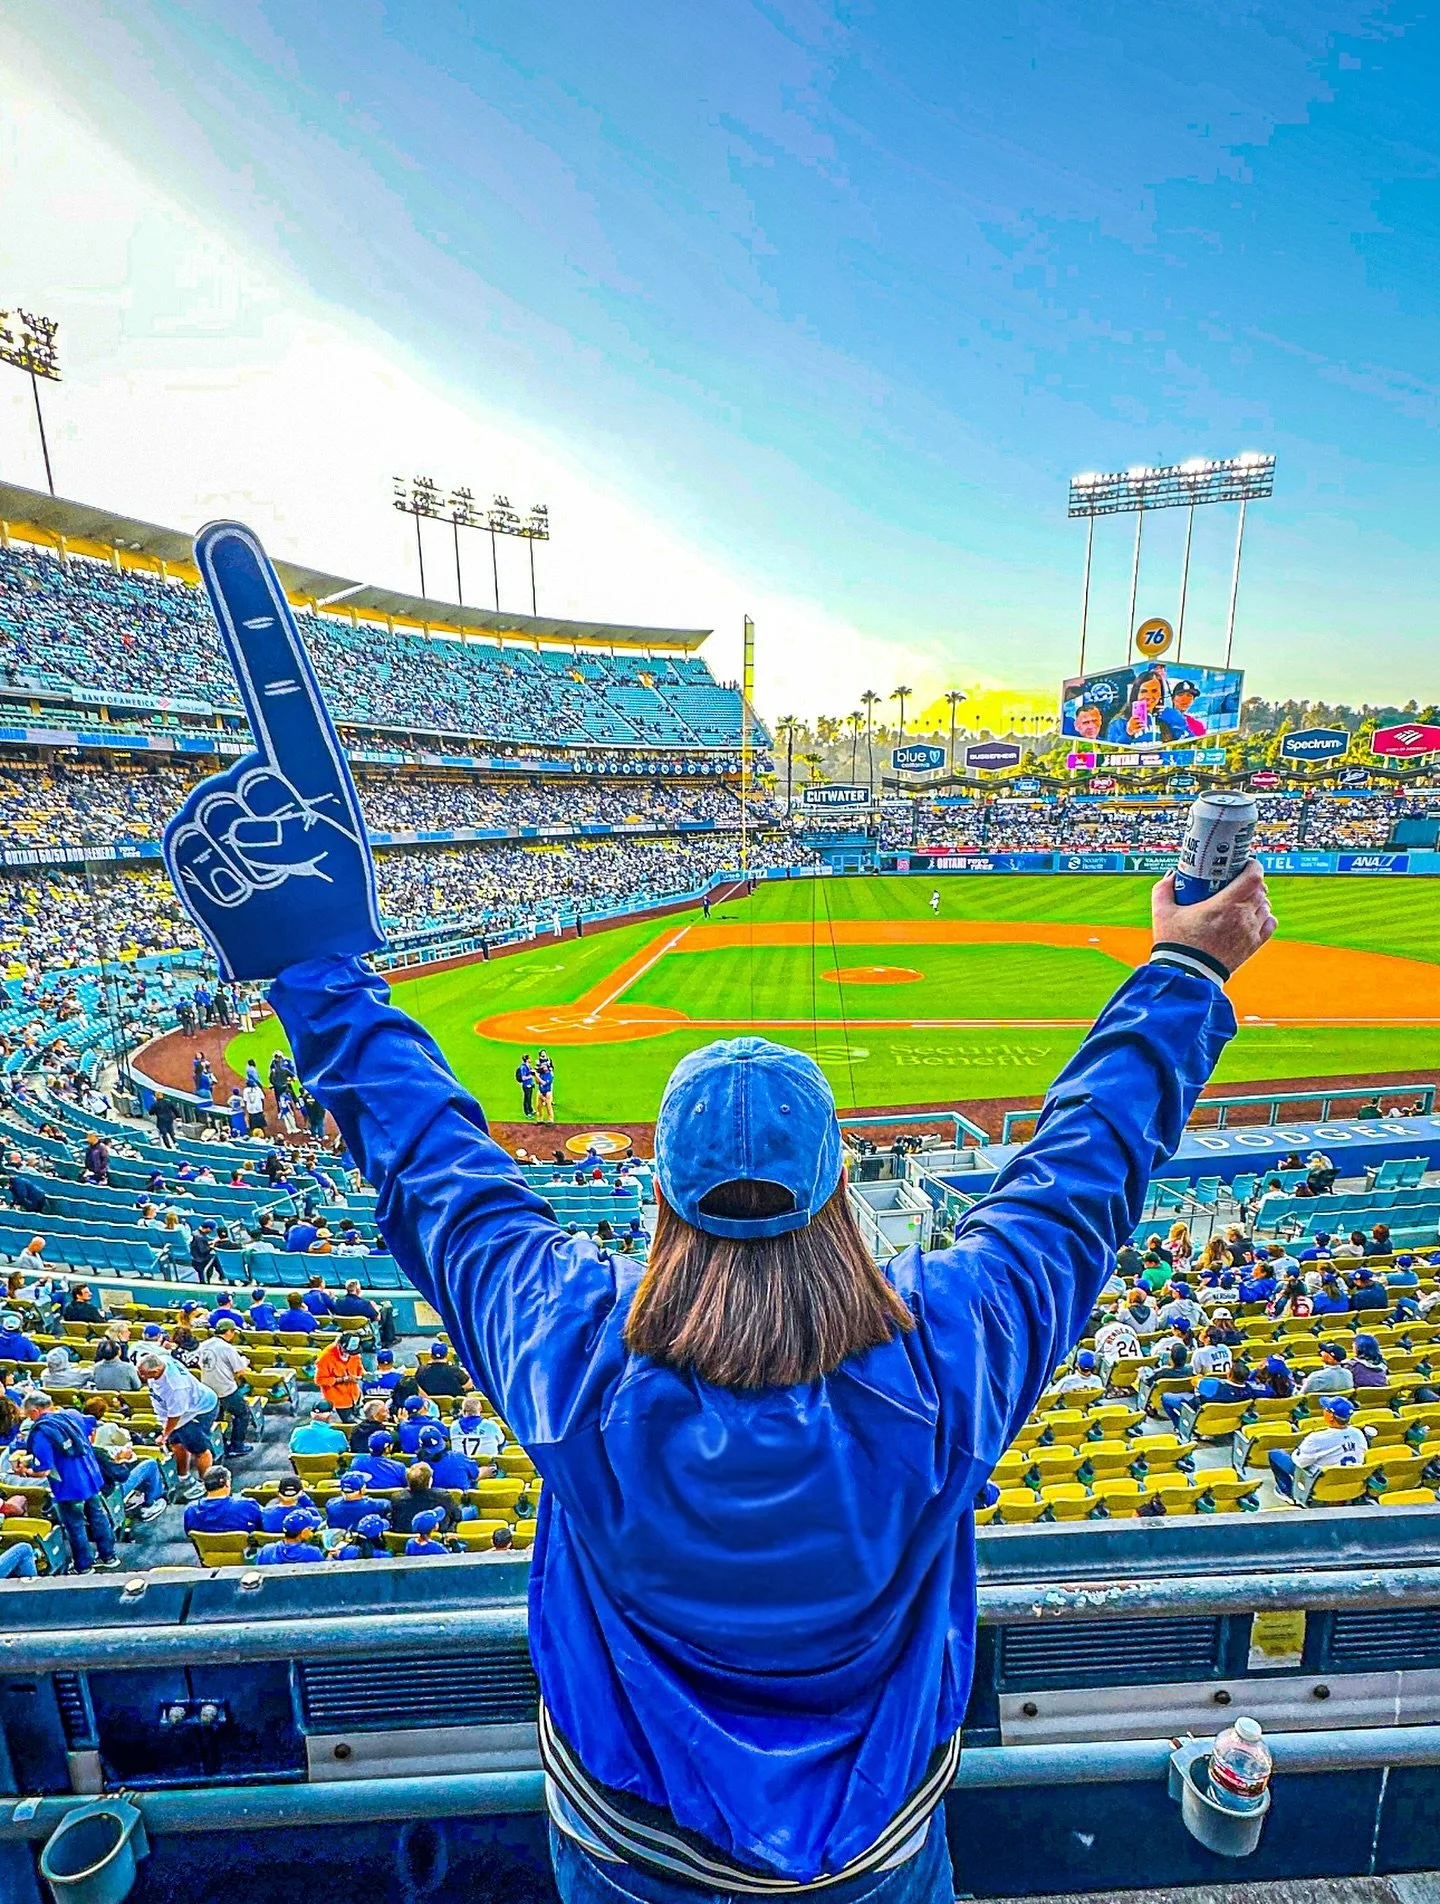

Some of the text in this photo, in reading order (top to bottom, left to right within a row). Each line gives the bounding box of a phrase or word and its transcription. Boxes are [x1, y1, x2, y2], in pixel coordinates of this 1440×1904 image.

[1144, 628, 1165, 645] 76
[81, 693, 155, 708] BANK OF AMERICA
[1286, 738, 1340, 752] Spectrum
[897, 750, 926, 763] blue
[806, 789, 867, 803] CUTWATER
[5, 849, 39, 865] OHTANI
[39, 848, 66, 863] 50/50
[1265, 857, 1295, 869] TEL
[1352, 856, 1380, 867] ANA
[936, 857, 967, 870] OHTANI
[890, 1044, 1053, 1057] Security
[896, 1055, 1041, 1066] Benefit
[1194, 1123, 1421, 1150] DODGER
[1117, 1340, 1138, 1357] 24
[1211, 1350, 1229, 1361] BETTS
[462, 1438, 480, 1456] 17
[1341, 1441, 1356, 1453] KIM
